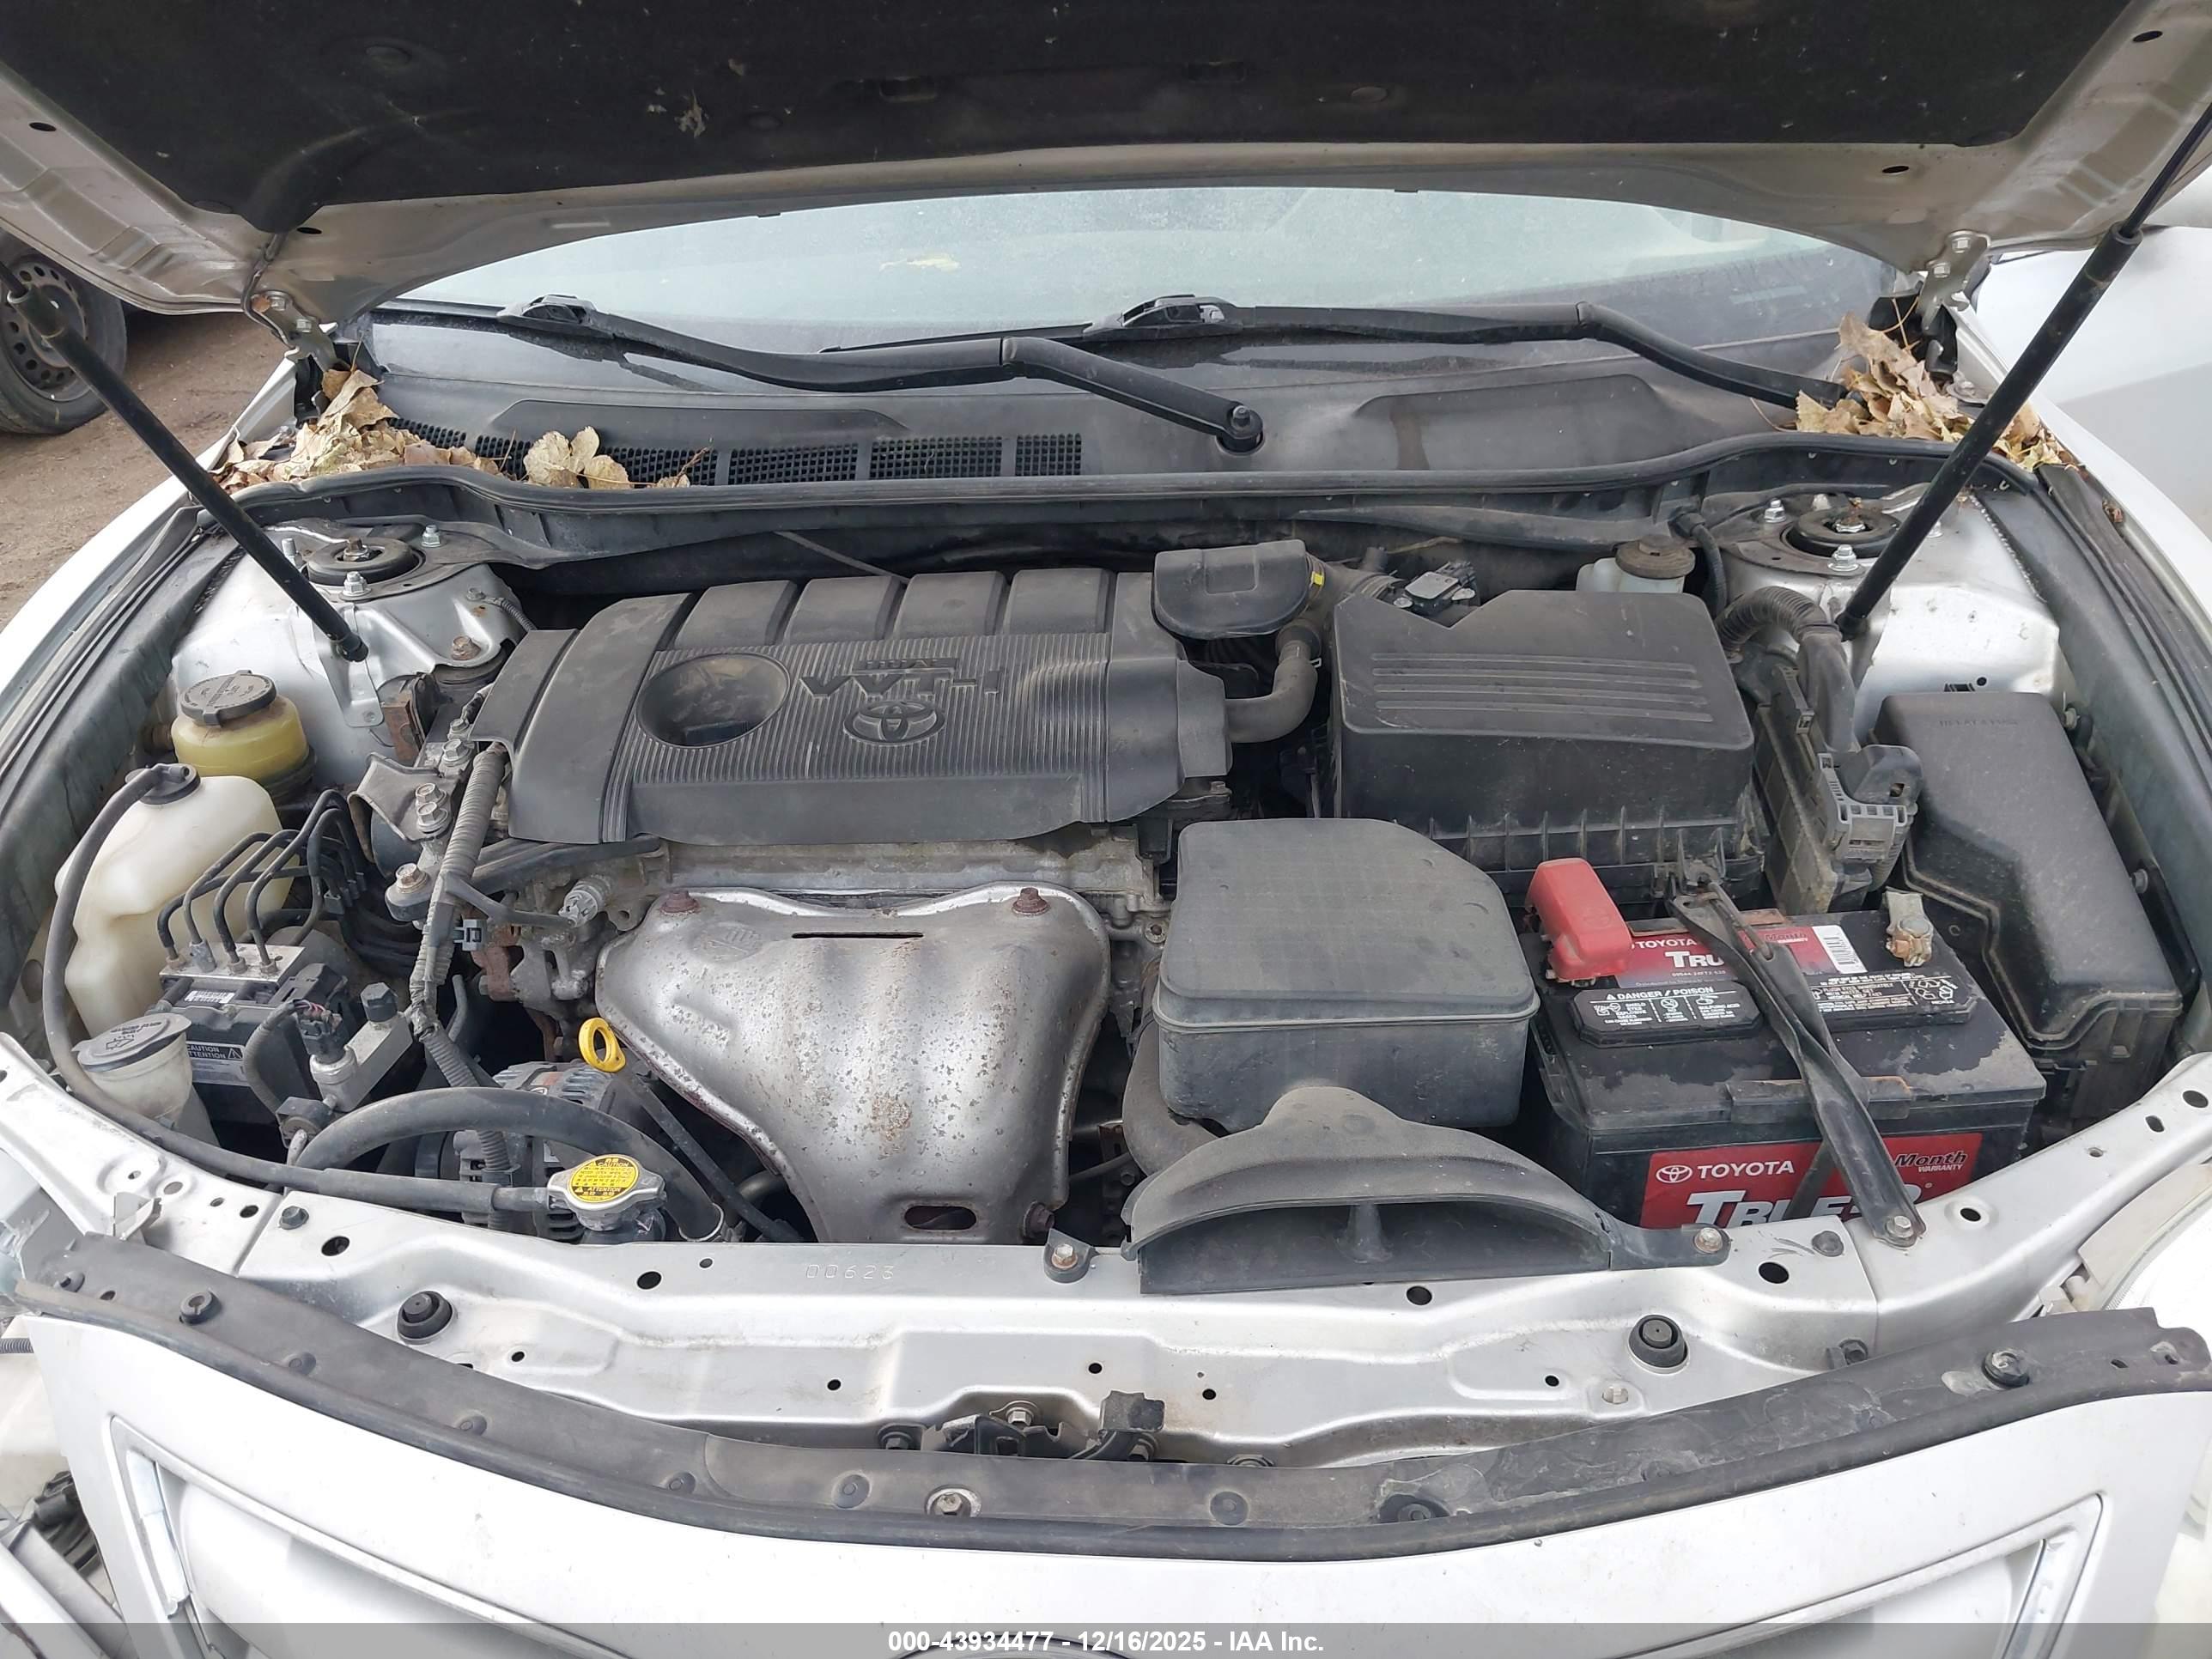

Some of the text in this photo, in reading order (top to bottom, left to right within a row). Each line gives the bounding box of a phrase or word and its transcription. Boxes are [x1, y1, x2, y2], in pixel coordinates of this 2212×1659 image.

[1636, 939, 1698, 950] TOYOTA
[1617, 991, 1662, 1000] DANGER
[1673, 987, 1714, 995] POISON
[1893, 1150, 1968, 1167] Month
[1697, 1160, 1796, 1179] TOYOTA
[1917, 1164, 1964, 1173] WARRANTY
